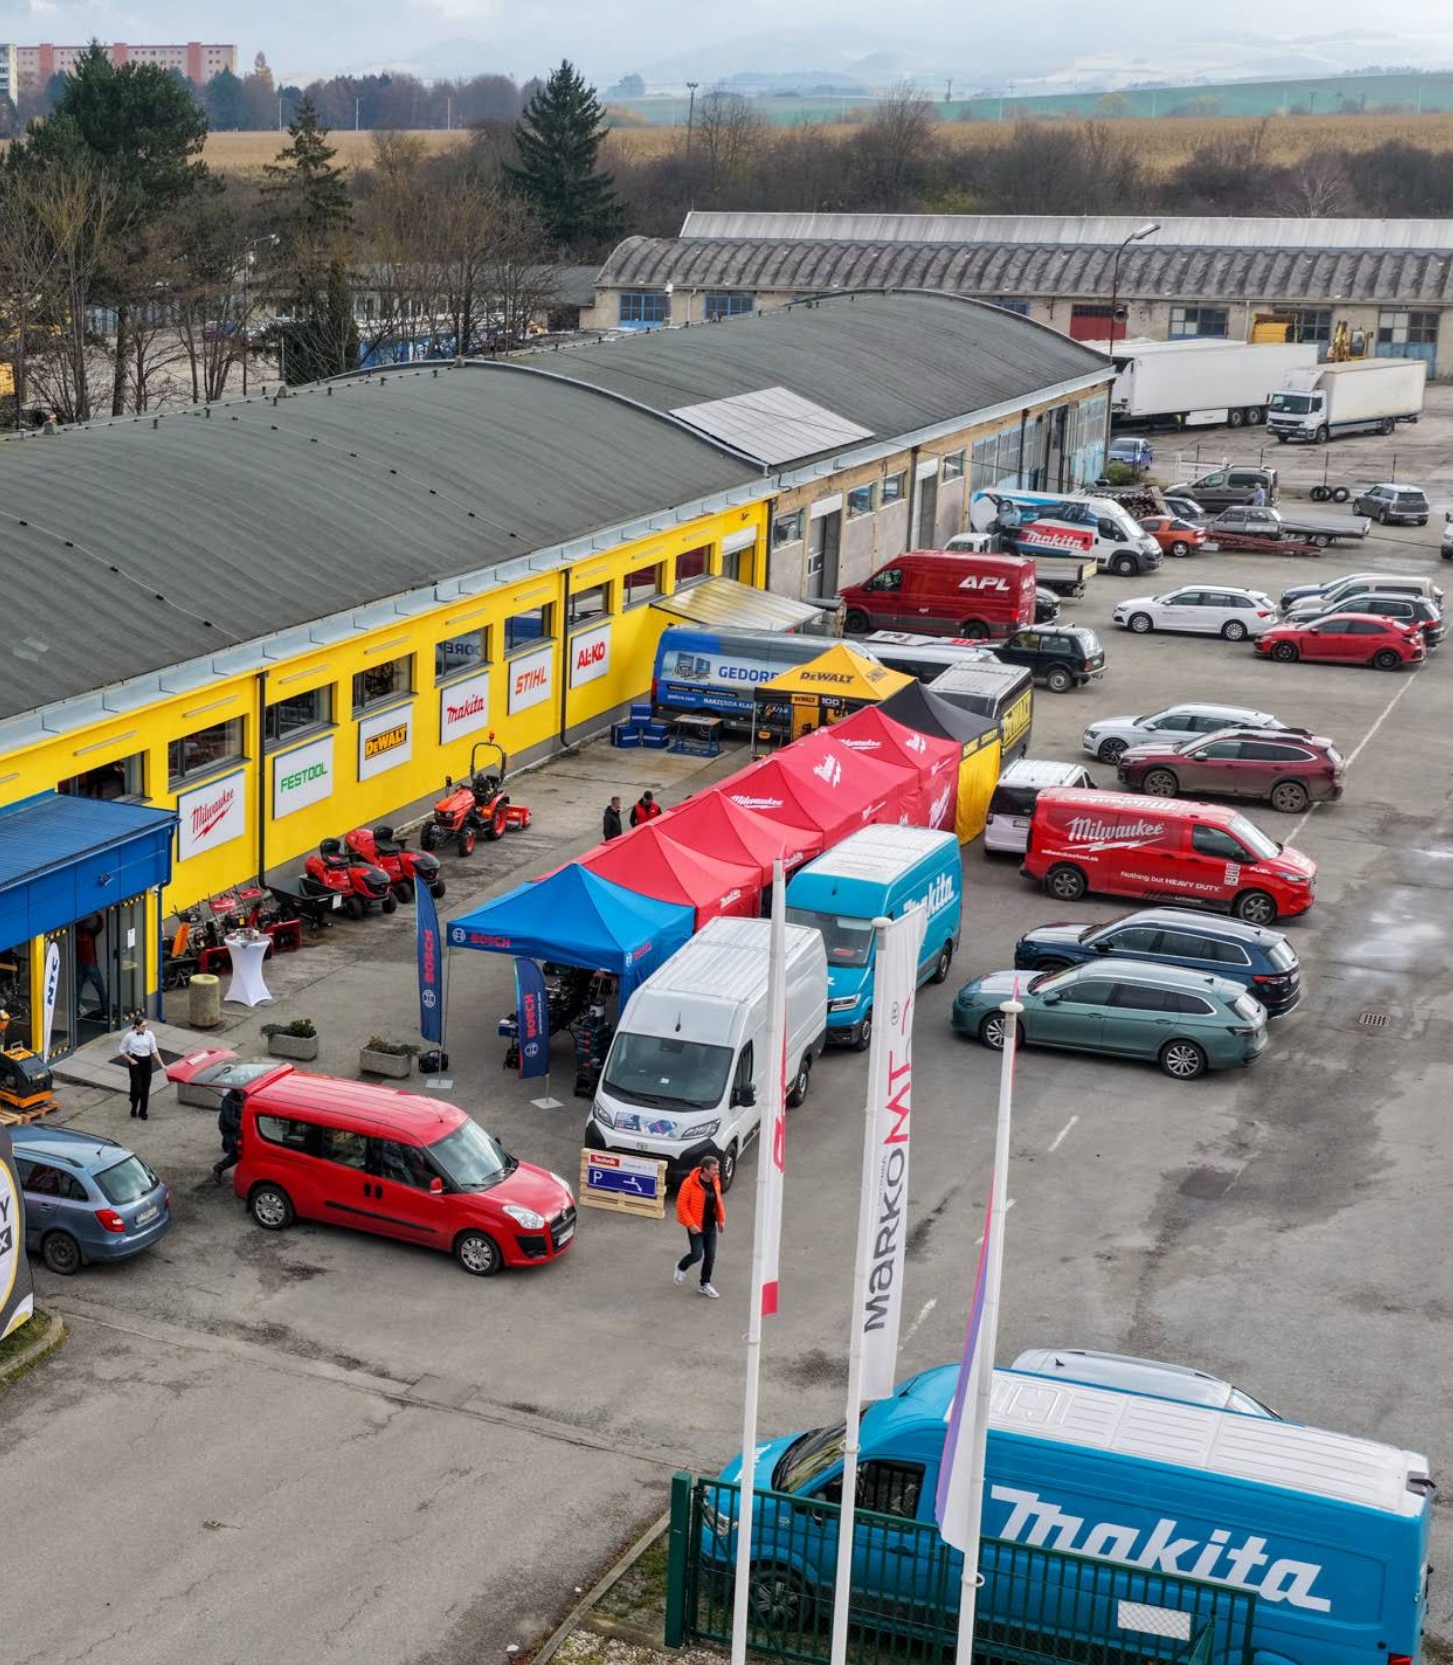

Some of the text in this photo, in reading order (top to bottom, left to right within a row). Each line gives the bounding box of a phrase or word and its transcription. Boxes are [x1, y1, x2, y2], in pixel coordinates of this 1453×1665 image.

[958, 575, 1010, 591] APL
[515, 666, 547, 695] STIHL
[280, 761, 328, 795] FESTOOL
[191, 788, 235, 834] Milwaukee
[1065, 816, 1165, 843] Milwaukee
[1121, 871, 1150, 882] Nothing
[1150, 876, 1164, 884] but
[1165, 878, 1194, 890] HEAVY
[470, 934, 511, 948] BOSCH
[424, 929, 435, 984] BOSCH
[524, 993, 537, 1039] BOSCH
[593, 1171, 603, 1184] P
